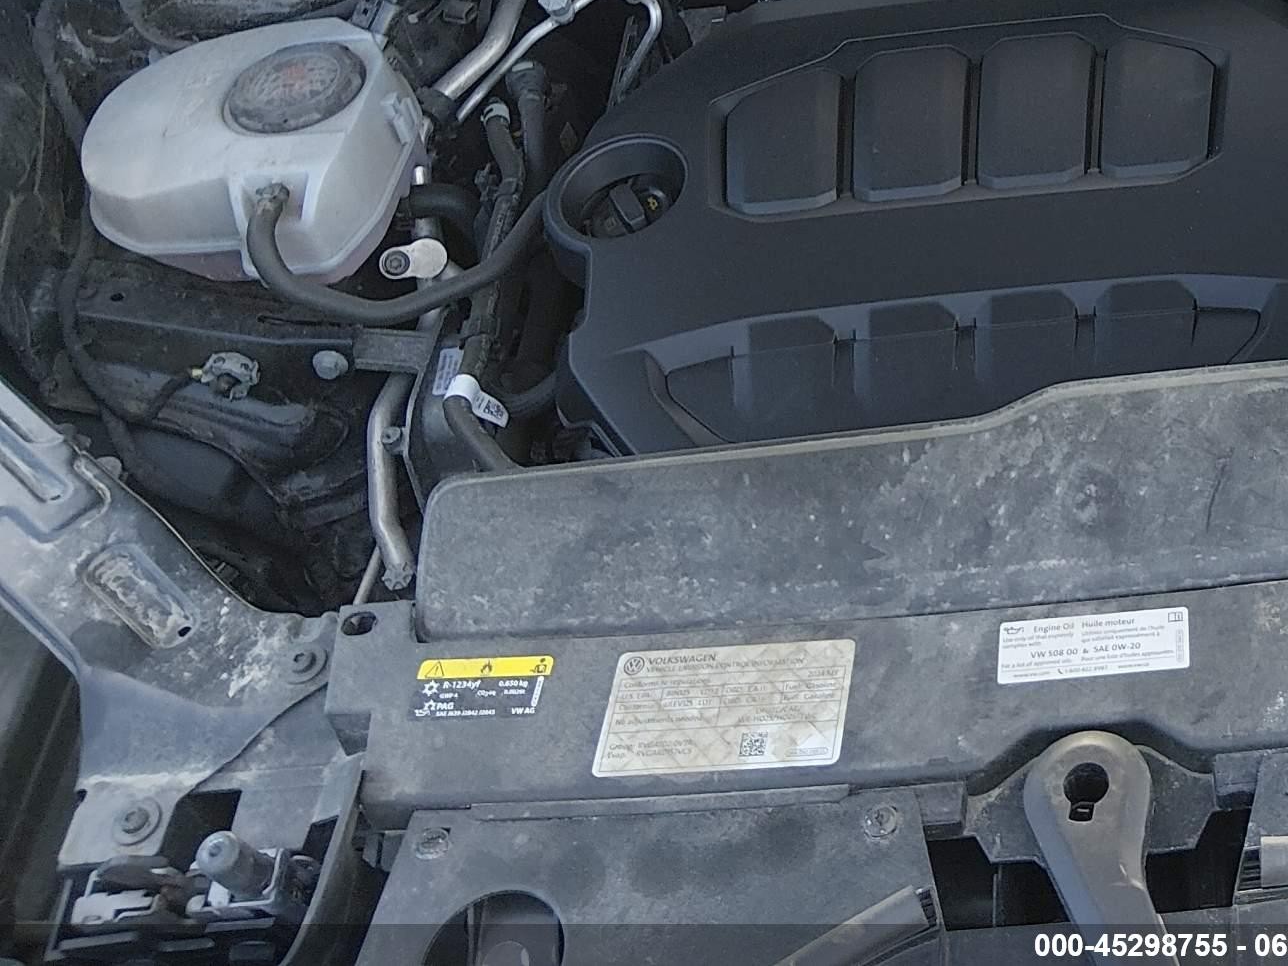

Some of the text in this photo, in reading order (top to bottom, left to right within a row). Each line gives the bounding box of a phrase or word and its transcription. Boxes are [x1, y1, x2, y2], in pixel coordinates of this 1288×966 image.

[1034, 622, 1074, 634] Engine Oil
[1082, 618, 1134, 628] Huile moteur
[1048, 649, 1064, 657] 508
[1094, 645, 1109, 653] SAE
[1112, 642, 1141, 651] 0W-20
[648, 654, 716, 665] VOLKSWAGEN
[443, 680, 481, 690] R-1234yf
[519, 679, 529, 688] kg
[437, 702, 454, 710] PAG
